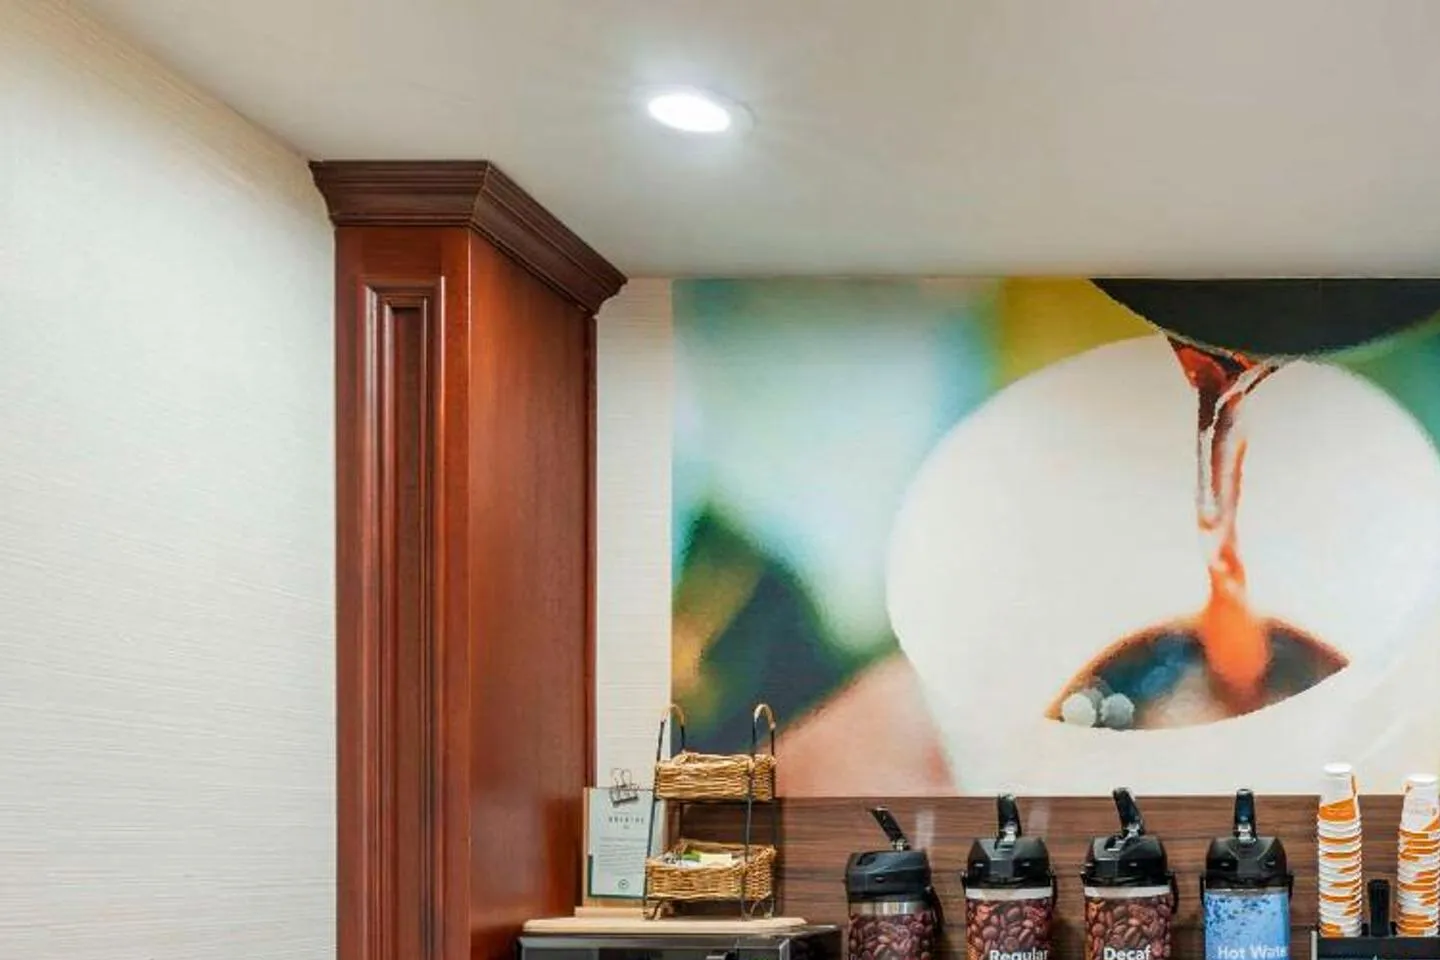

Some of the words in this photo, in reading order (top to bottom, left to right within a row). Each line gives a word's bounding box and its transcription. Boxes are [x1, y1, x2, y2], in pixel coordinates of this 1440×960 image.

[1103, 944, 1151, 960] Decaf
[1217, 945, 1246, 960] Hot
[1249, 944, 1289, 960] Wate
